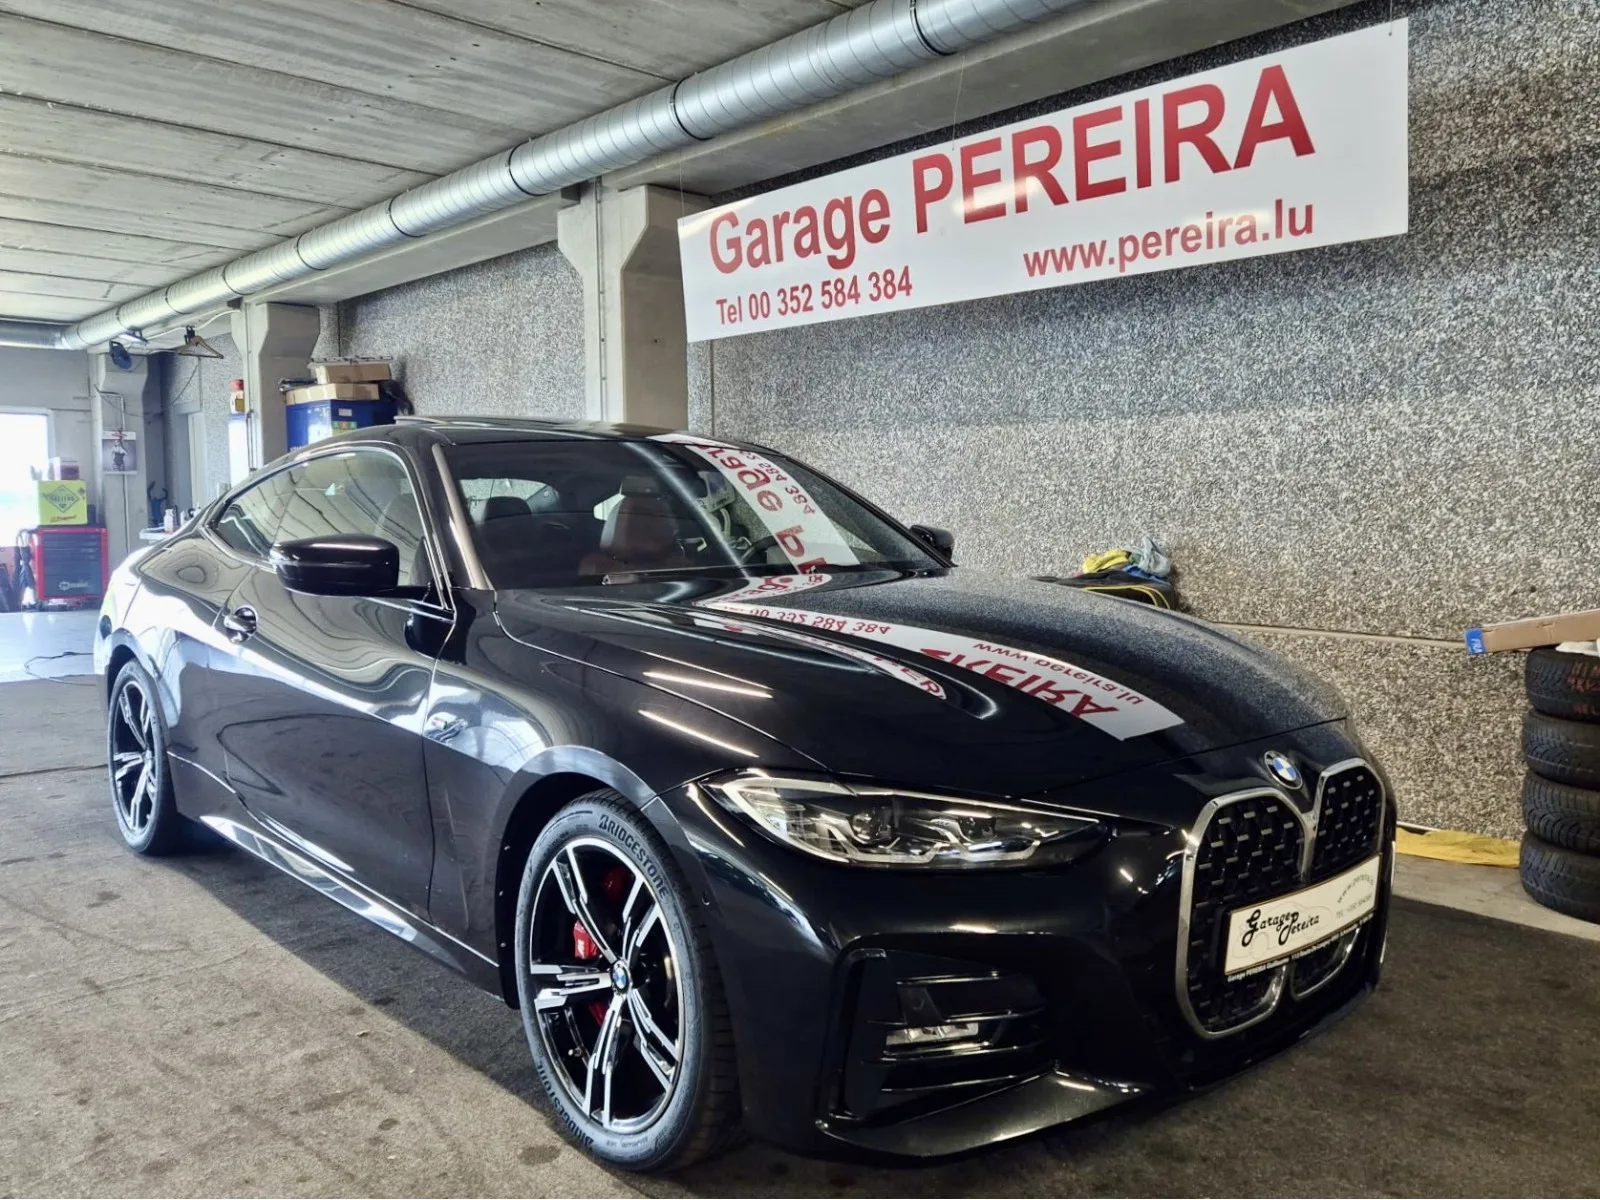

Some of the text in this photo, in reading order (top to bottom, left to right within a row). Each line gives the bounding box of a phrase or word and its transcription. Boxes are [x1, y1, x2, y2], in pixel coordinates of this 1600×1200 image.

[710, 64, 1316, 275] Garage PEREIRA
[1023, 198, 1314, 277] www.pereira.lu
[716, 265, 913, 325] Tel 00 352 584 384
[598, 814, 669, 899] BRIDGESTONE
[1241, 909, 1291, 947] Garage
[1278, 910, 1320, 946] Pereira
